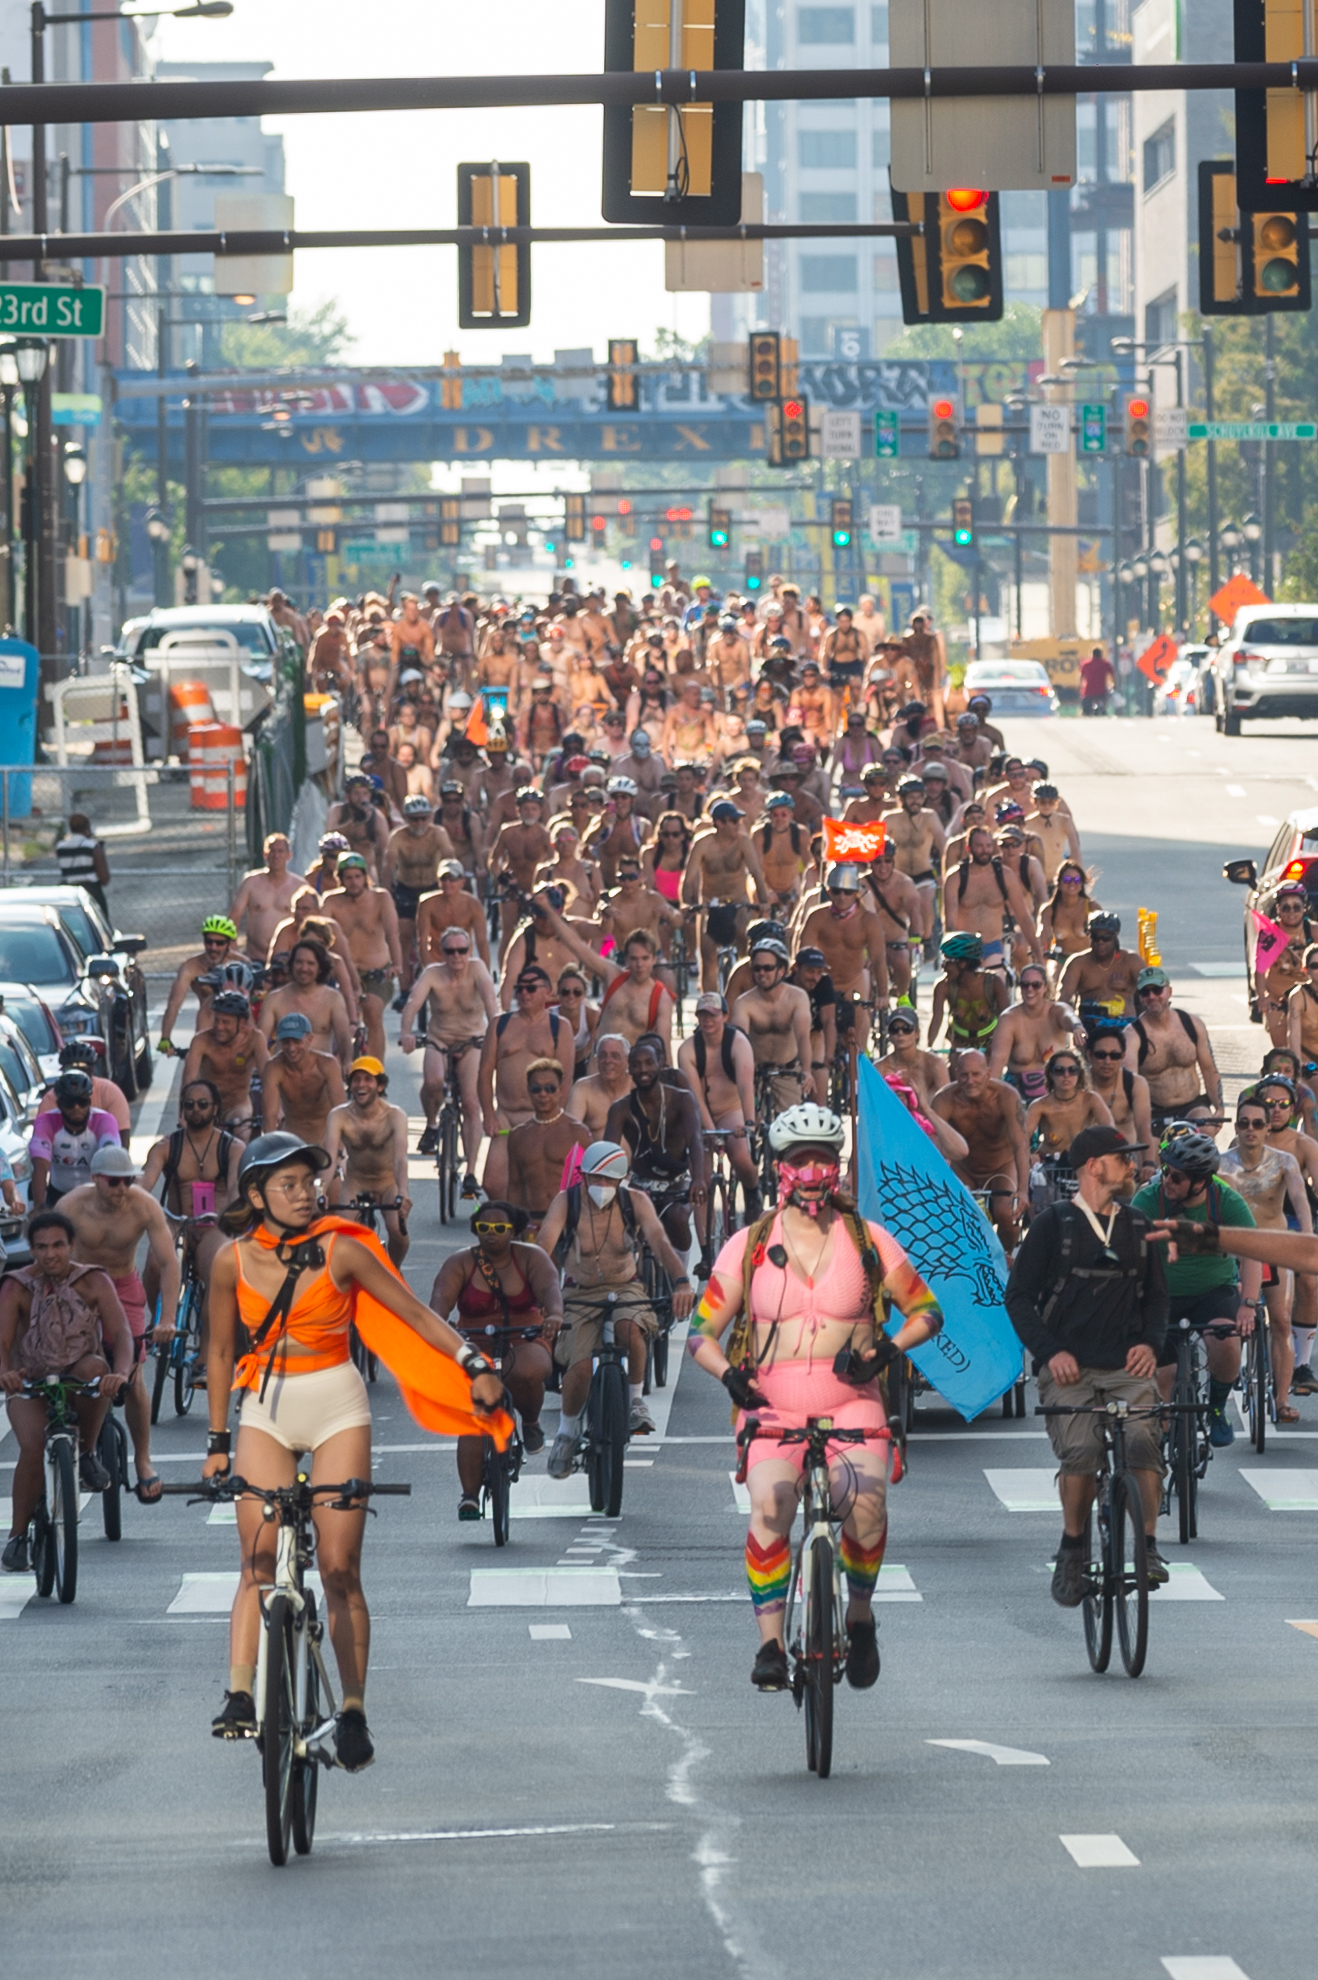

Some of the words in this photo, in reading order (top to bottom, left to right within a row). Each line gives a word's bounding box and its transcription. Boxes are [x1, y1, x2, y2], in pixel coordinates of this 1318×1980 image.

[0, 293, 48, 326] 3rd
[56, 296, 83, 327] St
[1041, 409, 1061, 421] NO
[1036, 422, 1064, 431] TURN
[1276, 424, 1297, 438] AVE
[828, 429, 854, 439] TURN
[1044, 431, 1058, 440] ON
[1041, 440, 1061, 449] RED
